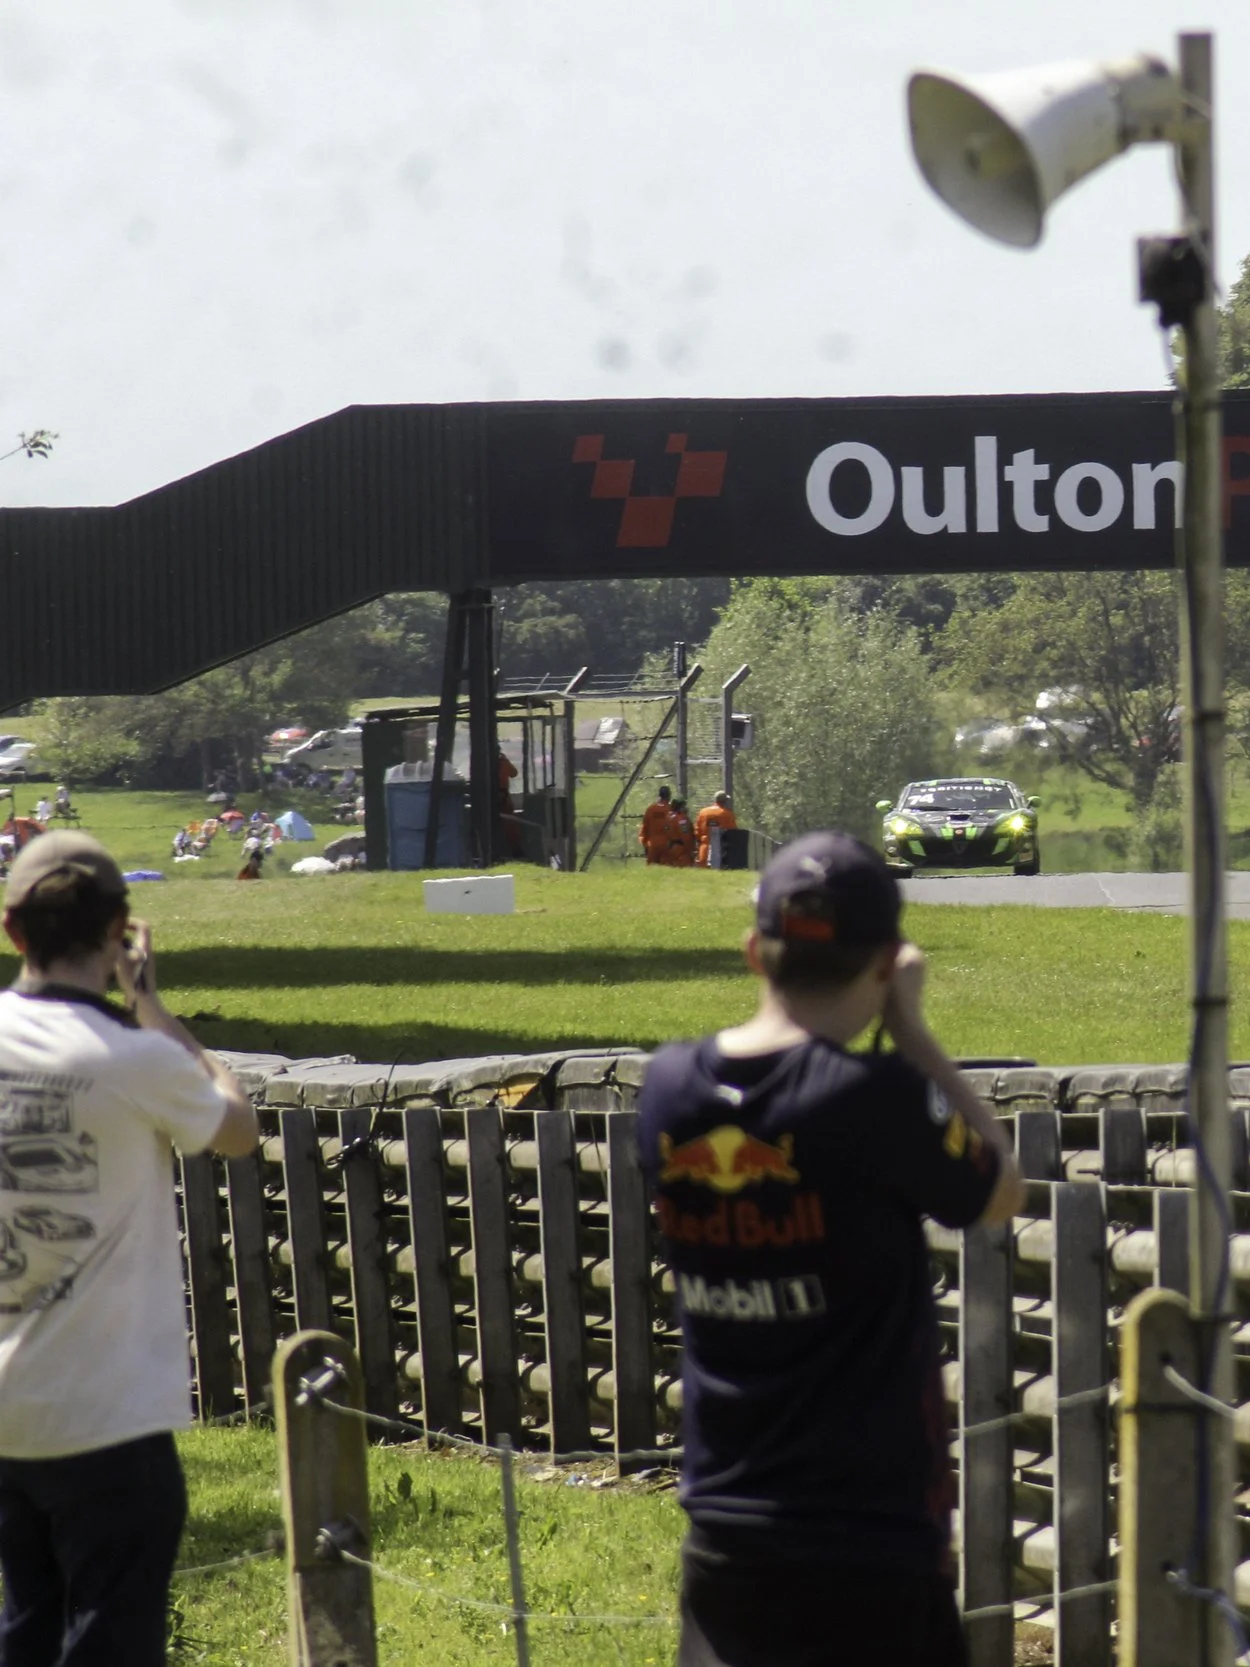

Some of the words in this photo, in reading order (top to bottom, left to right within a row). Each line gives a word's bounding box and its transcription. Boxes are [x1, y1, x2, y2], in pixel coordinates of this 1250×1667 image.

[907, 793, 935, 805] 74
[734, 1191, 825, 1247] Bull
[680, 1273, 777, 1322] Mobil
